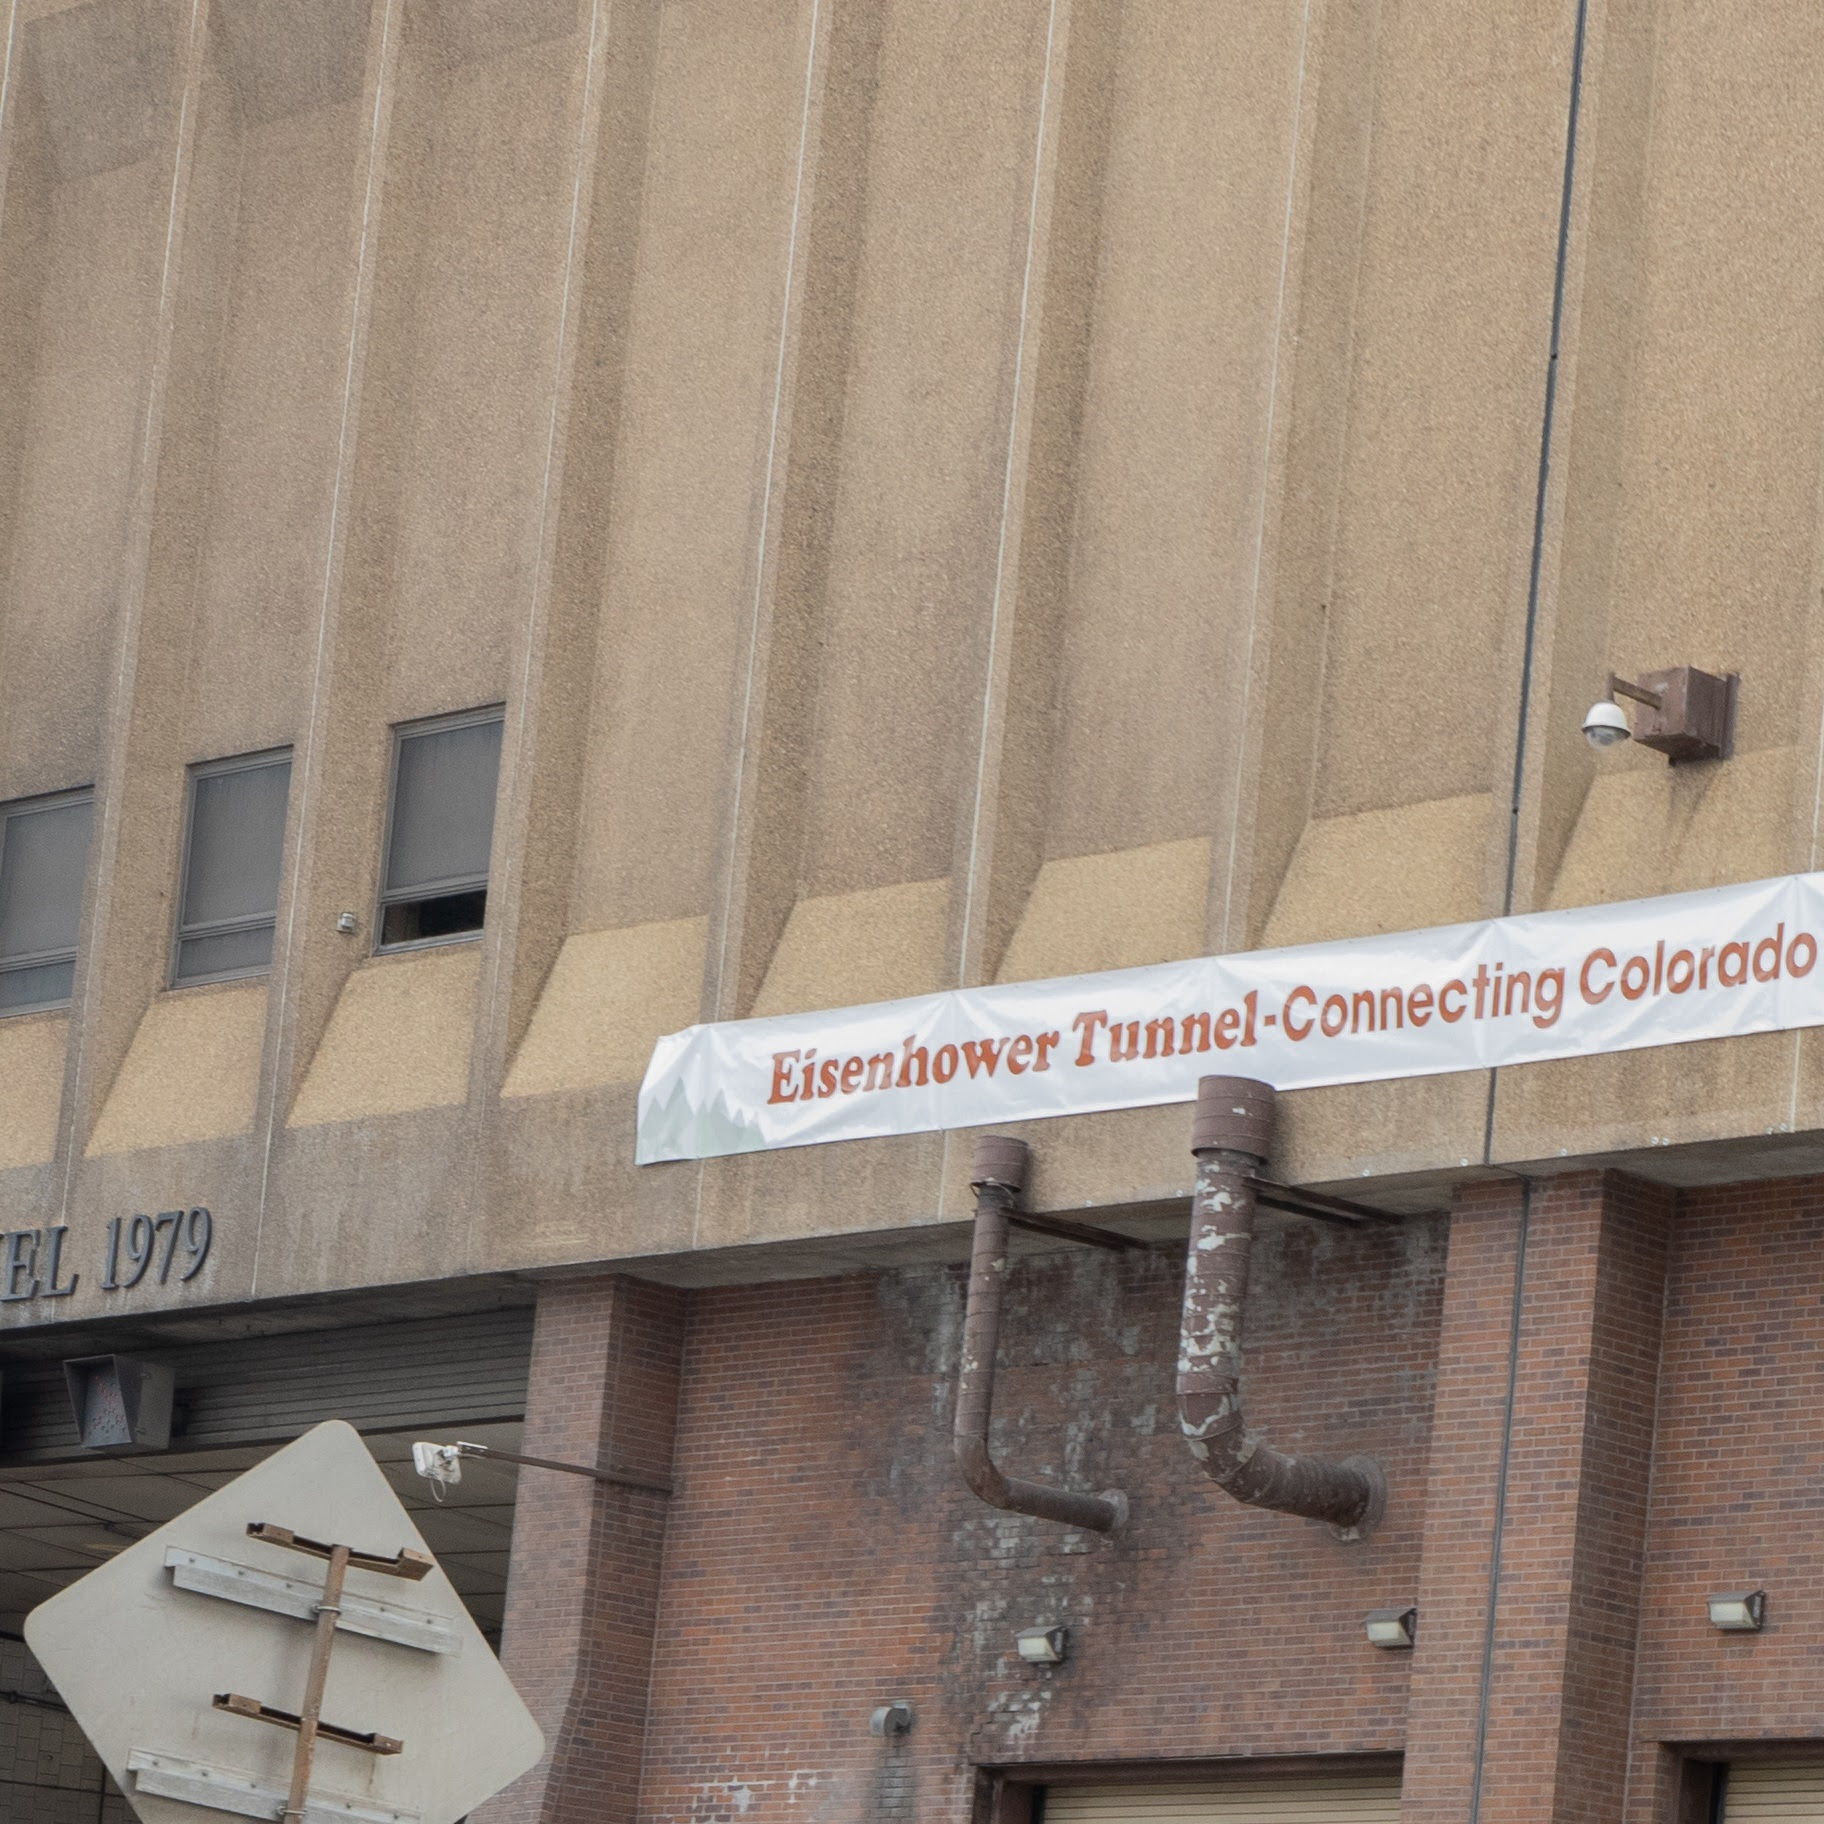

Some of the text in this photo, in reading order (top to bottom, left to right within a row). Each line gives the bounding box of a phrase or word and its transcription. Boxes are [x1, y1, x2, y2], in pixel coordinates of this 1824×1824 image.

[767, 1027, 1061, 1105] Eisenhower
[1578, 923, 1817, 1001] Colorado
[0, 1206, 213, 1301] EL 1979
